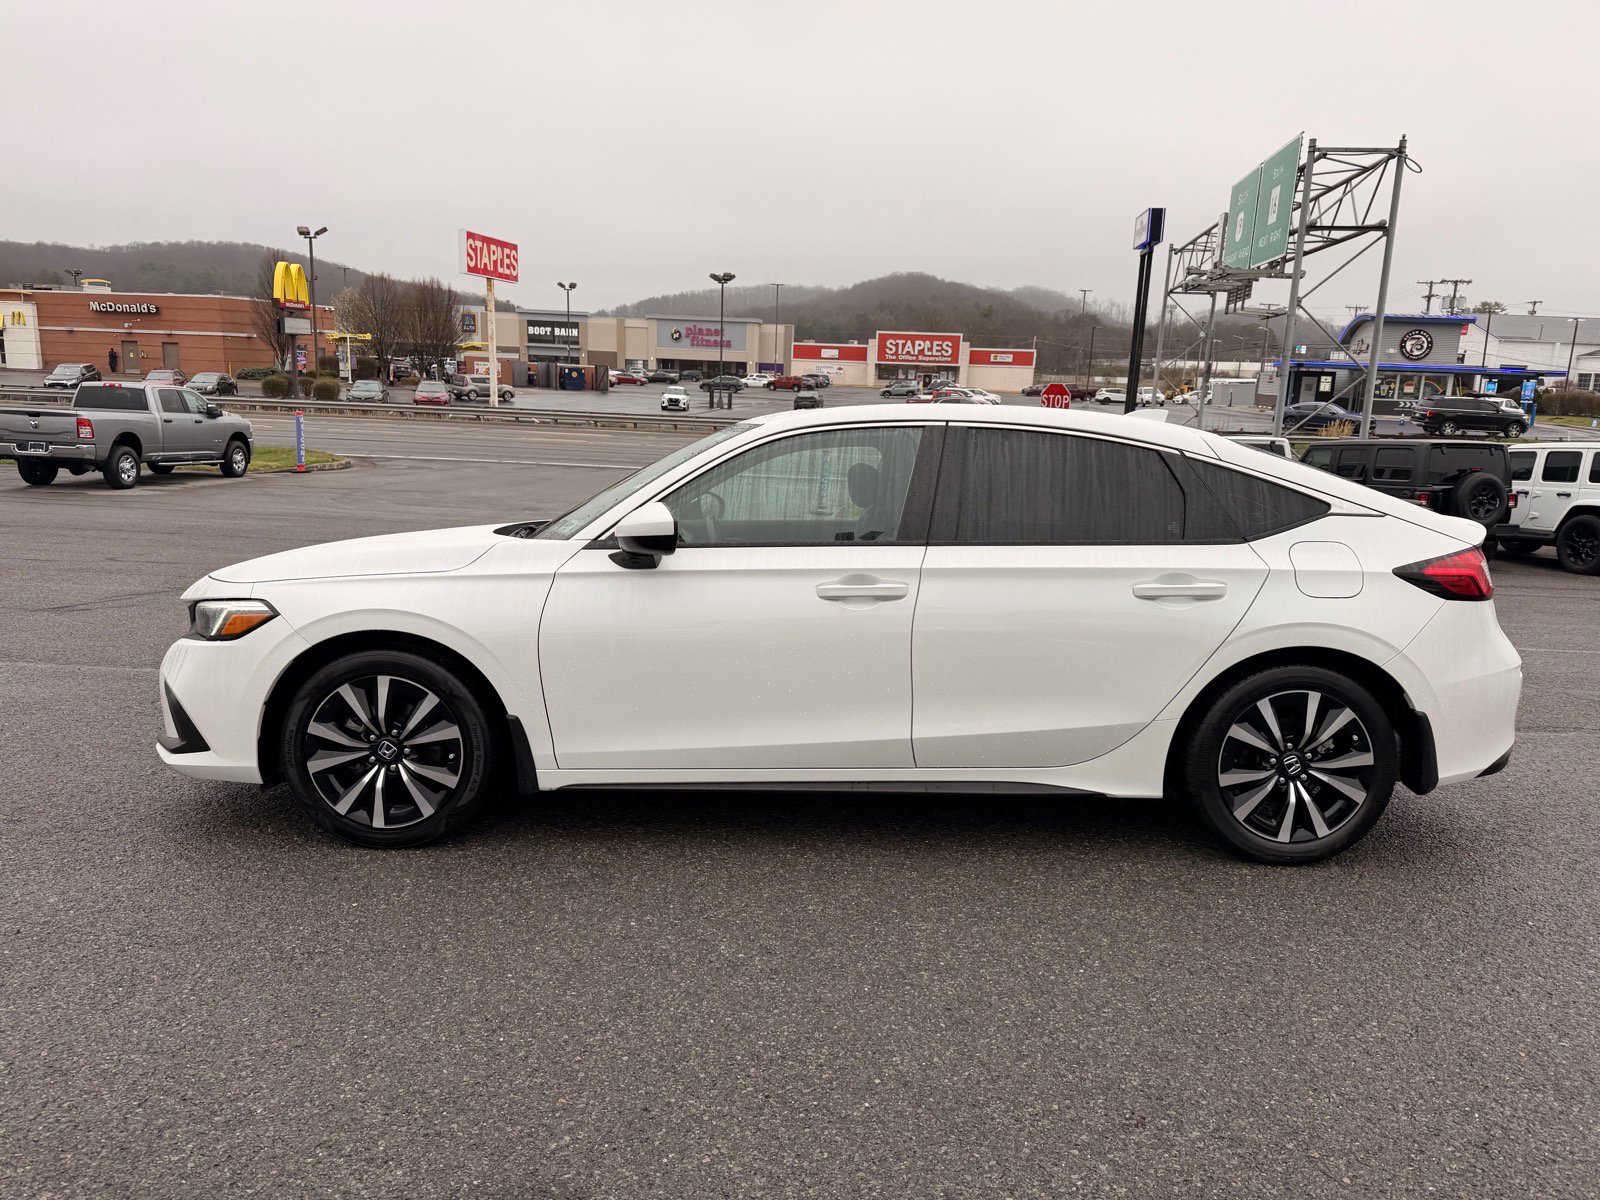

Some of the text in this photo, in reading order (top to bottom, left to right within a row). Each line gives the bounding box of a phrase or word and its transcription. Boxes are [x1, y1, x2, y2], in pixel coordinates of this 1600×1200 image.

[467, 238, 517, 276] STAPLES
[89, 301, 157, 313] McDonald's
[528, 326, 552, 336] BOOT
[885, 339, 953, 356] STAPLES
[1041, 394, 1070, 408] STOP
